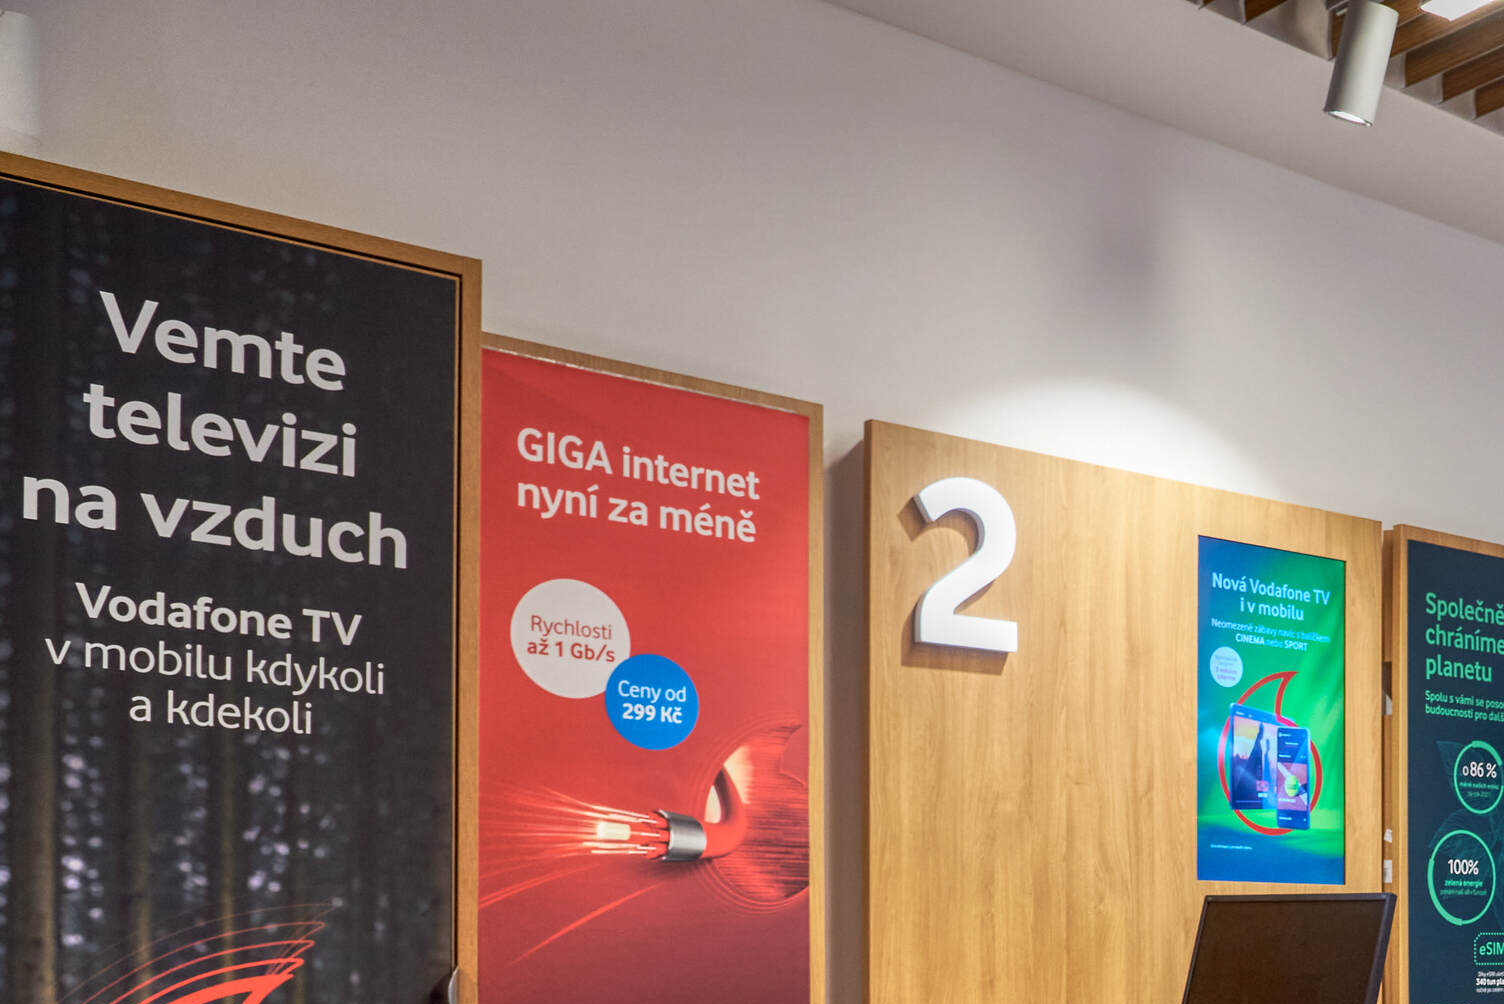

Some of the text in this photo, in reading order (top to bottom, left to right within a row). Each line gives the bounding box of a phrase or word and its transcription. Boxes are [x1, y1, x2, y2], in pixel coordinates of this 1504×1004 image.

[100, 291, 346, 391] Vemte
[83, 383, 357, 477] televizi
[517, 428, 760, 500] GIGA internet
[22, 476, 407, 569] na vzduch
[517, 482, 756, 543] nyní za méně
[915, 477, 1018, 653] 2
[1212, 572, 1331, 605] Nová Vodafone TV
[75, 582, 362, 646] Vodafone TV
[1240, 597, 1304, 621] i v mobilu
[531, 615, 613, 641] Rychlosti
[1235, 633, 1265, 645] CINEMA
[1284, 640, 1308, 651] SPORT
[45, 638, 385, 696] v mobilu kdykoli
[527, 640, 616, 663] až 1 Gb/s
[1425, 654, 1492, 682] planetu
[618, 680, 687, 703] Ceny od
[1425, 690, 1448, 703] Spolu
[1455, 694, 1474, 706] vámi
[1475, 698, 1485, 707] se
[129, 690, 312, 734] a kdekoli
[622, 702, 683, 724] 299 Kč
[1425, 703, 1473, 718] budoucnosti
[1474, 711, 1487, 721] pro
